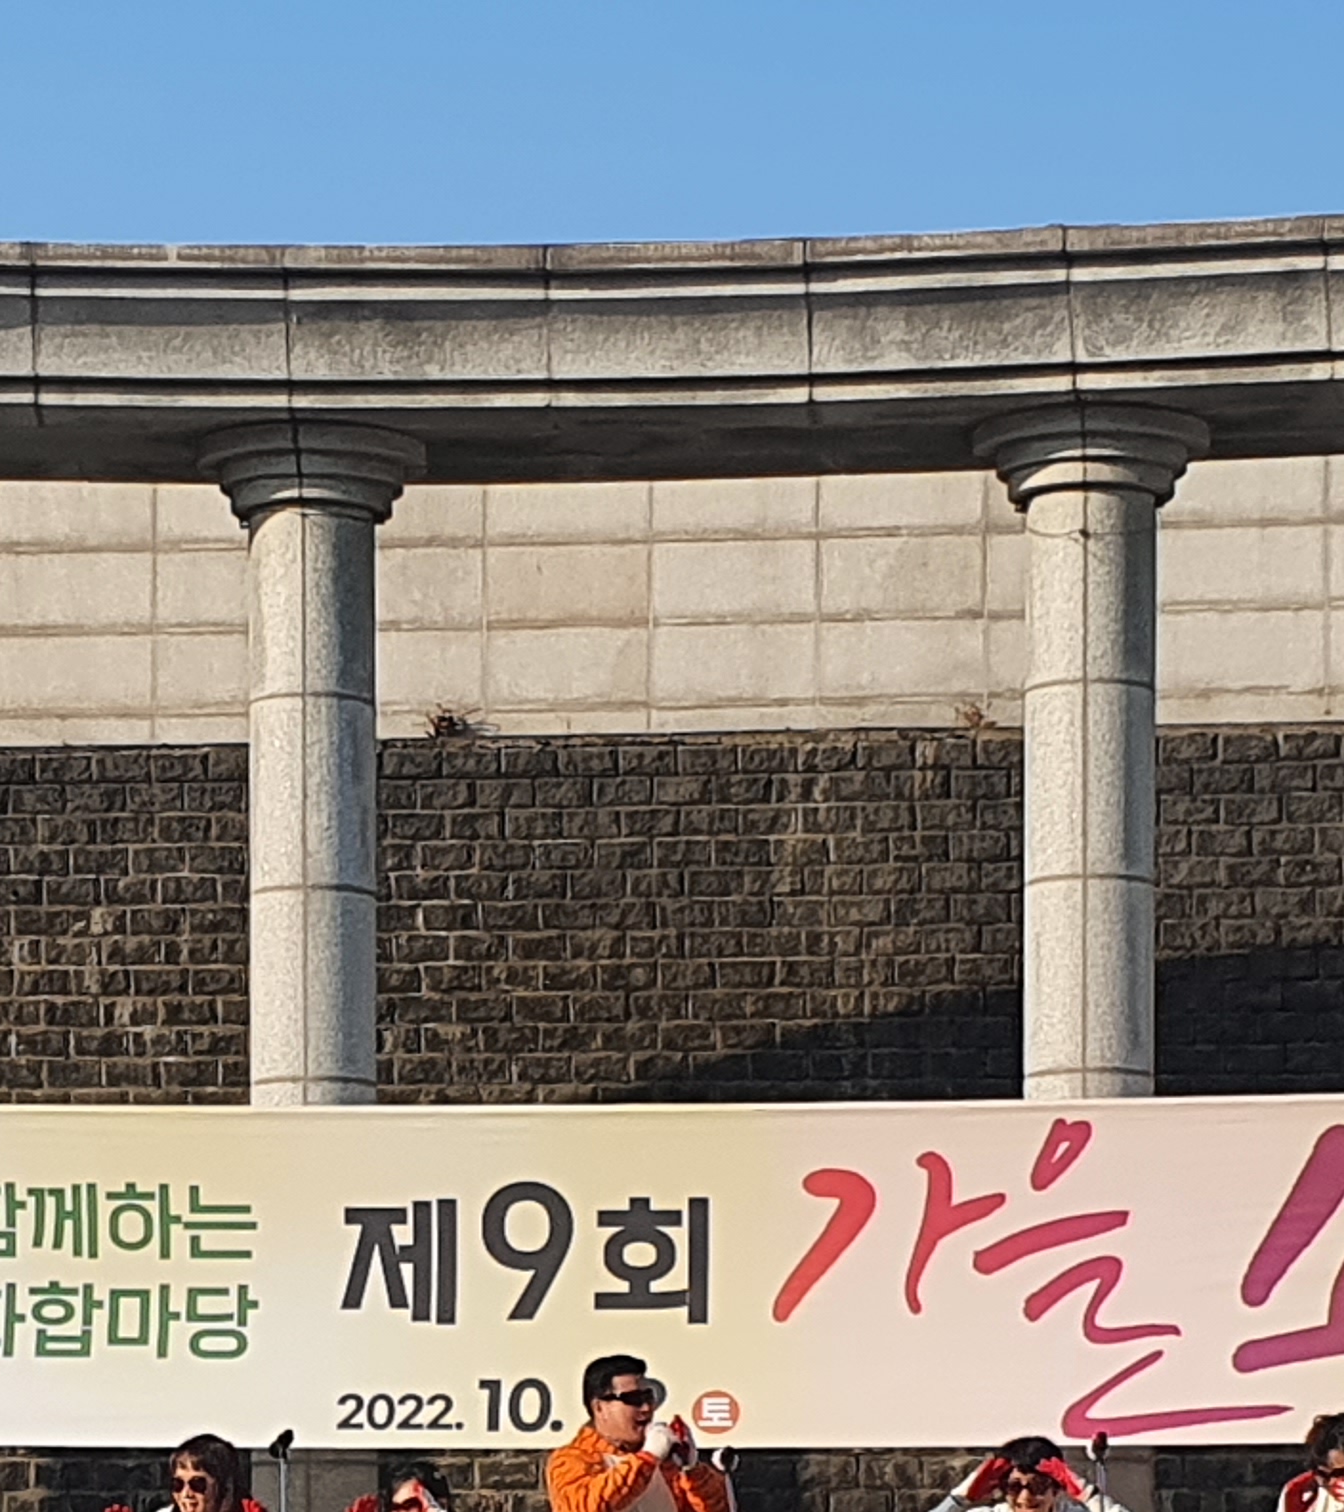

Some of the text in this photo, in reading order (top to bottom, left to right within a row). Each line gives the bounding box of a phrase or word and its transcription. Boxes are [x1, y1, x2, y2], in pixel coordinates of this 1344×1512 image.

[340, 1181, 710, 1325] 제9회
[772, 1117, 1294, 1438] 가을
[697, 1398, 735, 1428] 토
